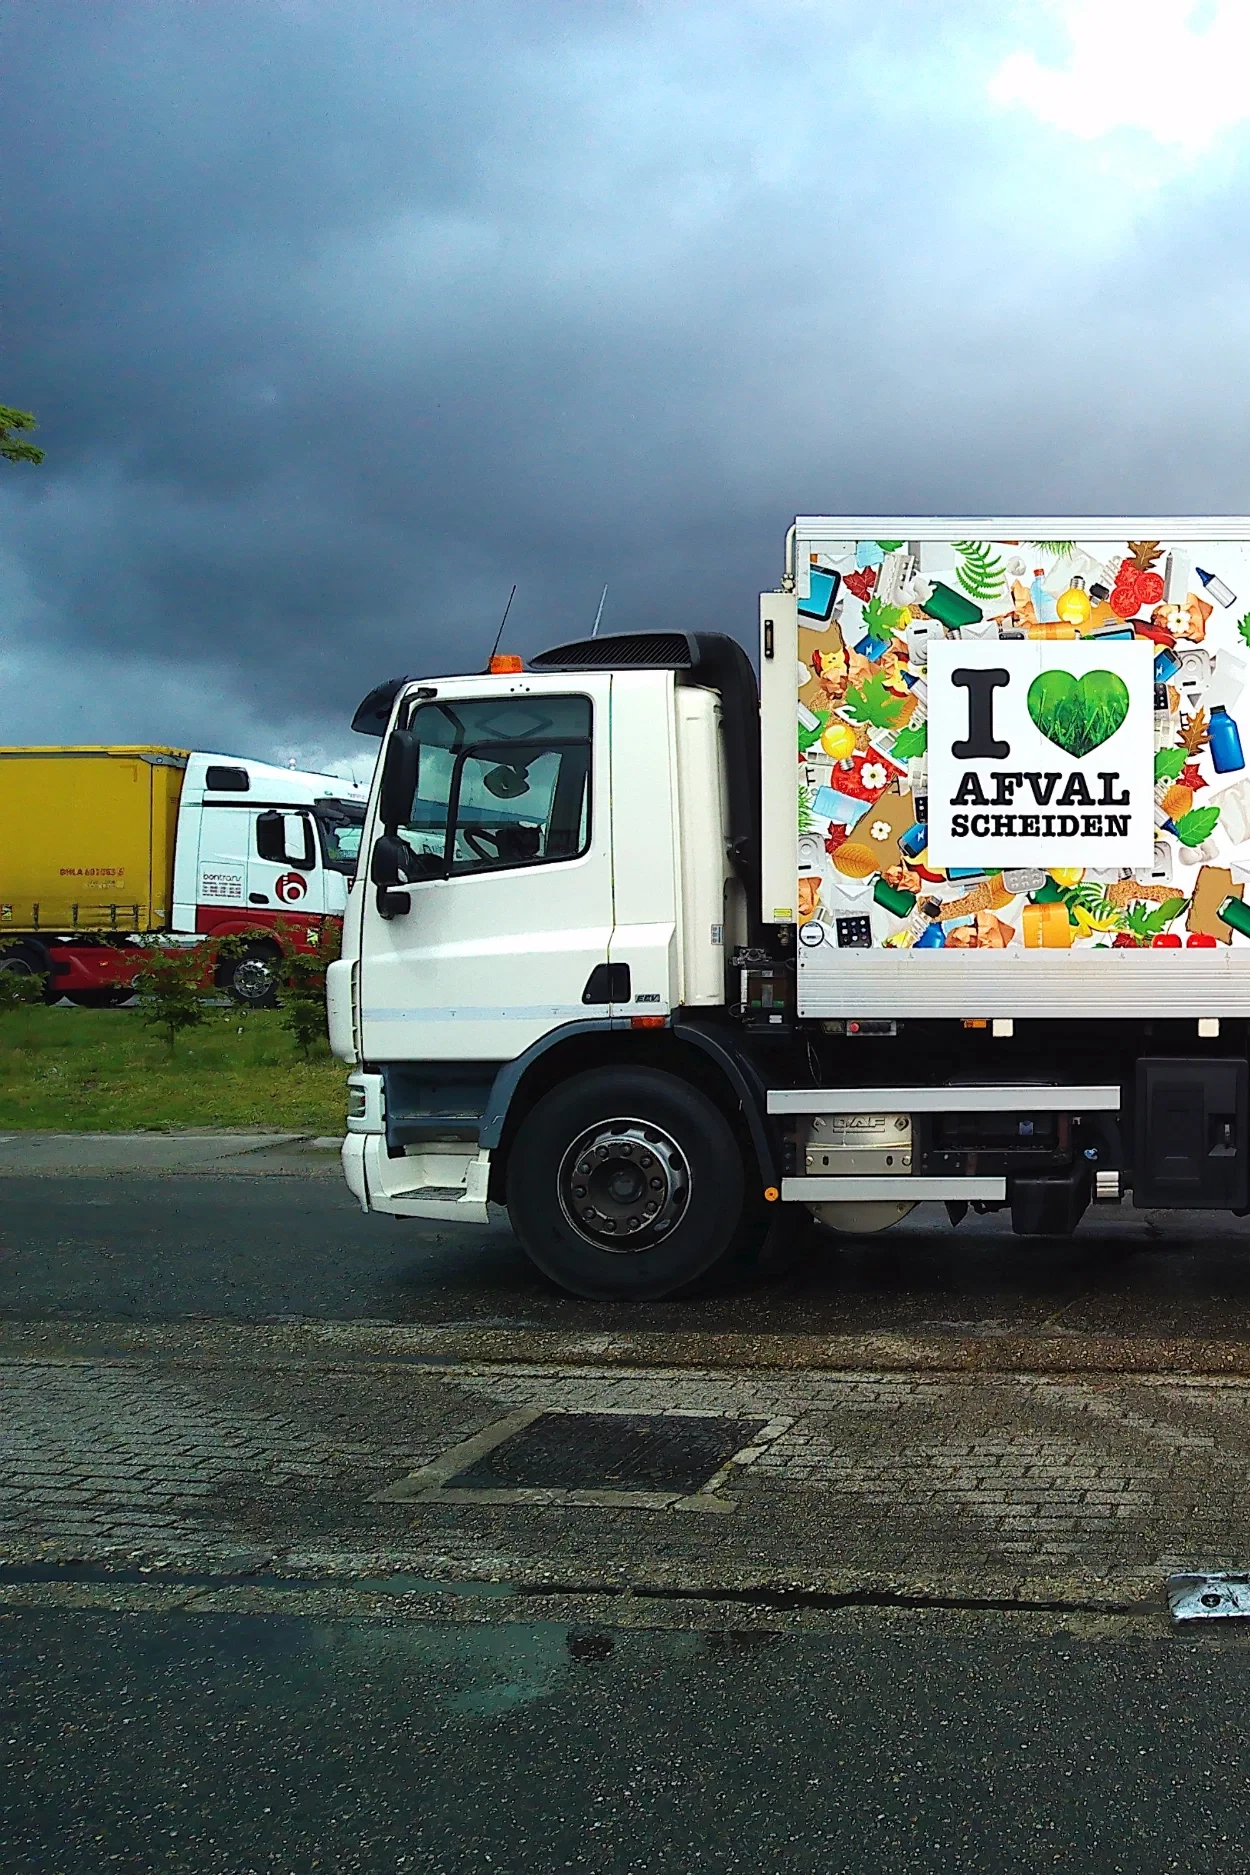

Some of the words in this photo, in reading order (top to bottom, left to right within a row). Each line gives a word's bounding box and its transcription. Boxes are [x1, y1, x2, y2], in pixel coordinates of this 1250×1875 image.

[951, 668, 1010, 760] I
[950, 772, 1131, 806] AFVAL
[950, 814, 1132, 837] SCHEIDEN
[833, 1117, 885, 1129] DAF
